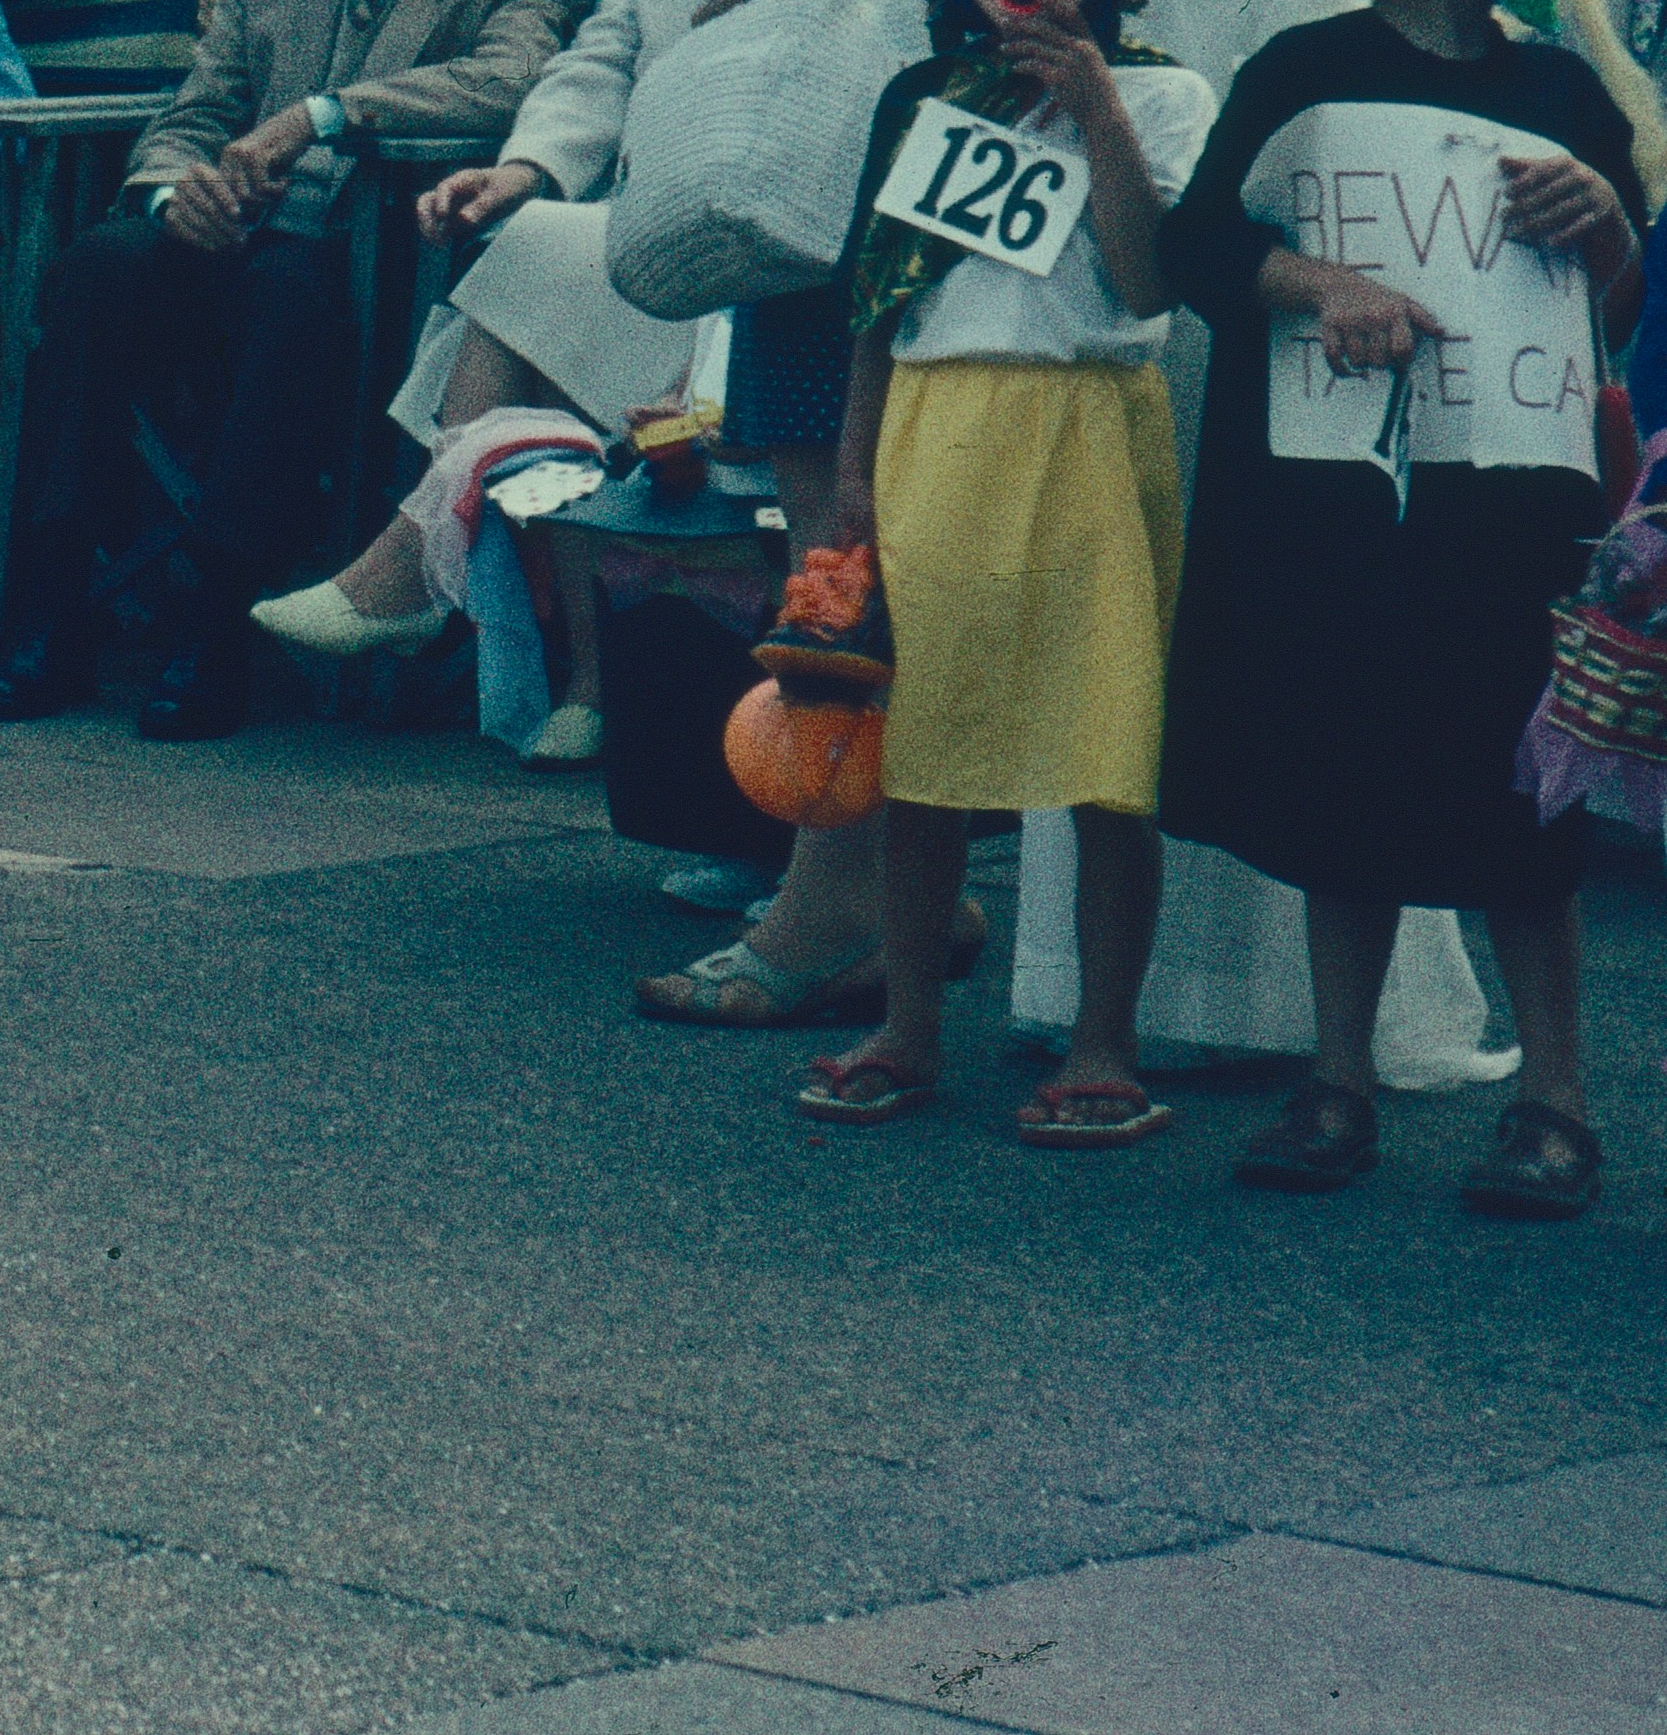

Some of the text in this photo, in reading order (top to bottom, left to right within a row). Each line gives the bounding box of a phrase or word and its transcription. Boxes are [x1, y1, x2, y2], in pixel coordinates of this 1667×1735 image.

[914, 126, 1066, 252] 126
[1291, 334, 1588, 413] TE CA
